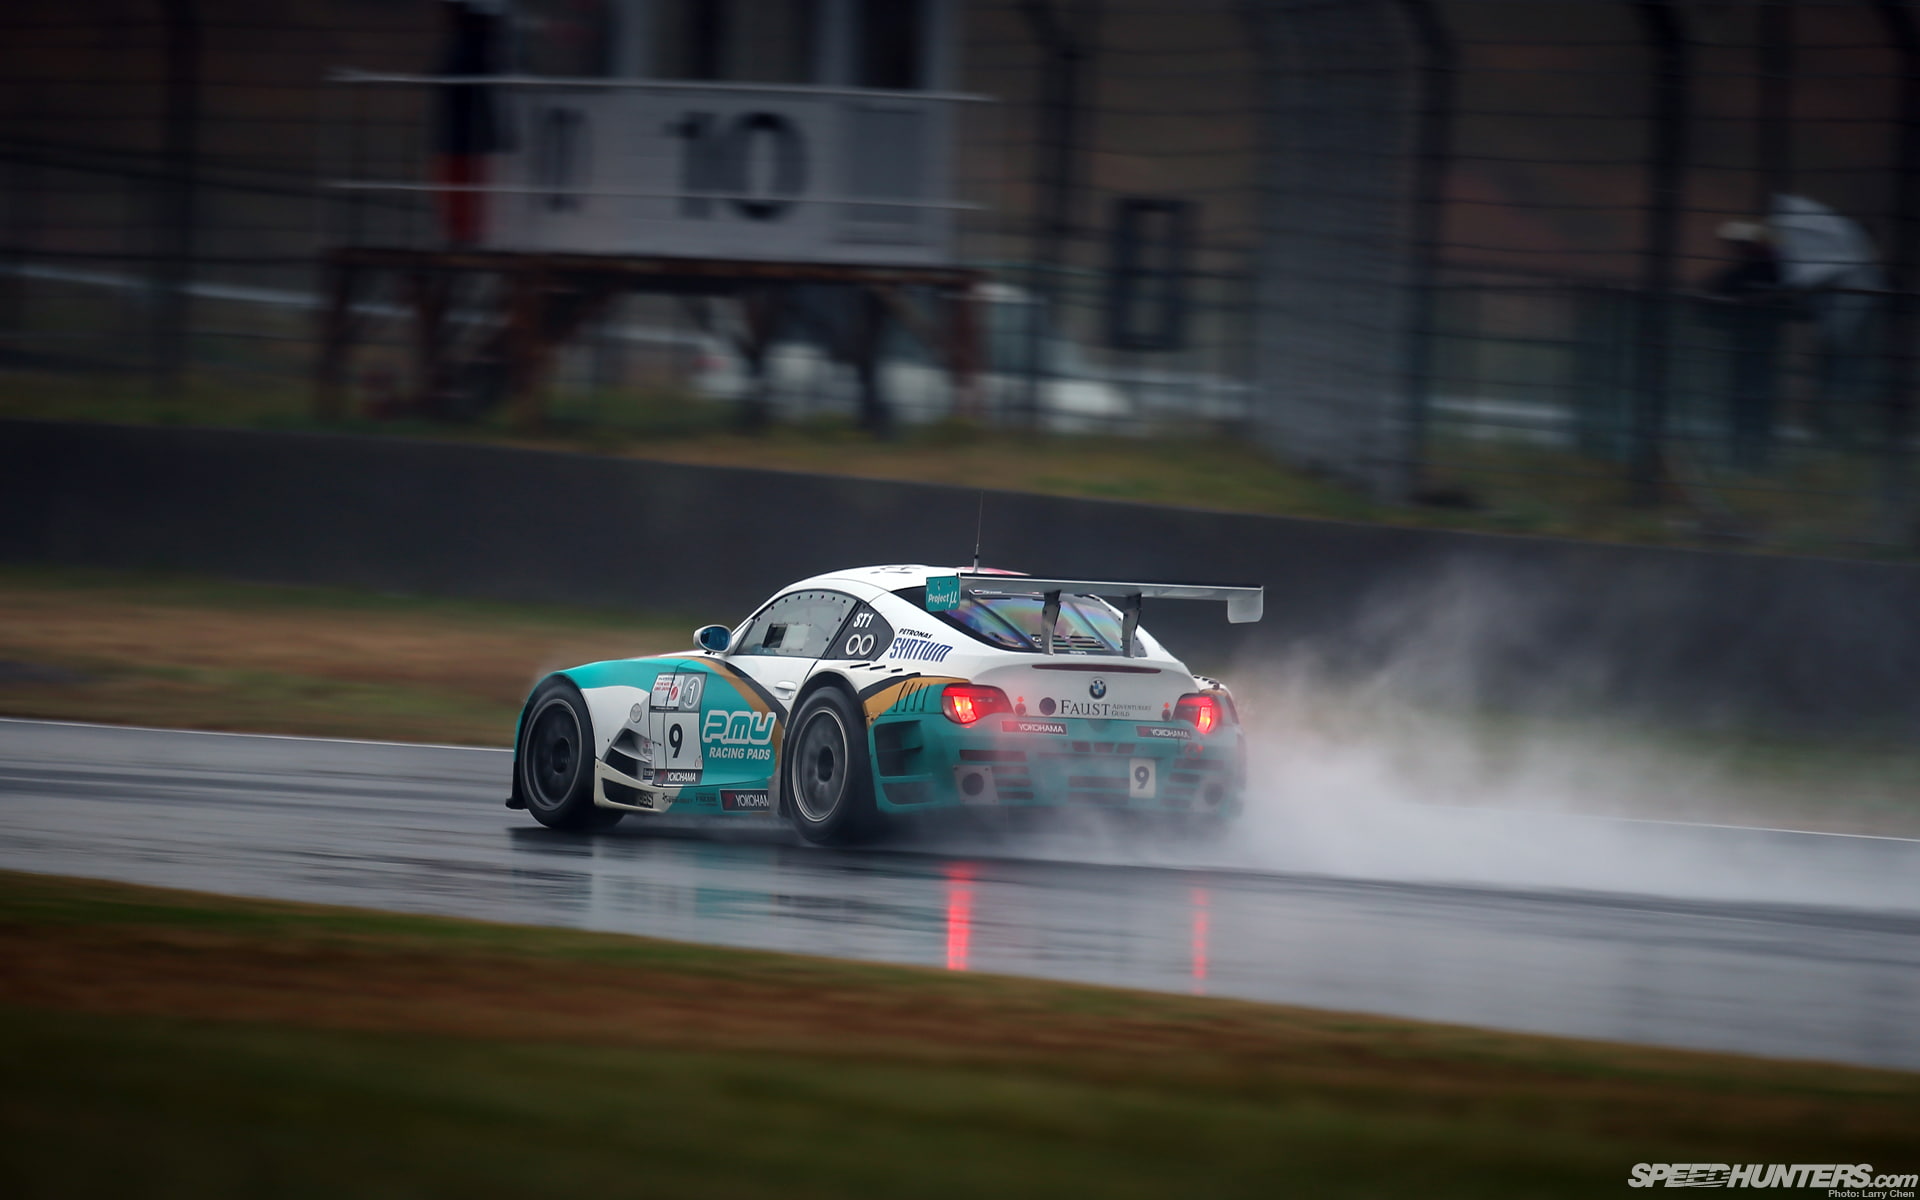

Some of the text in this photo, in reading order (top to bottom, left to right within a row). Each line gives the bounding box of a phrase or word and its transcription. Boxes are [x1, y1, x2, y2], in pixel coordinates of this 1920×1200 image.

[660, 109, 810, 222] 10
[928, 593, 949, 604] Project
[853, 613, 874, 628] ST1
[898, 628, 933, 639] PETRONAS
[889, 637, 953, 662] SYNTIUM
[1060, 699, 1110, 716] FAUST
[1018, 723, 1064, 733] YOKOHAMA
[1150, 728, 1190, 738] YOKOHAMA
[669, 723, 683, 758] 9
[709, 747, 771, 760] RACING PADS
[667, 771, 696, 782] YOKOHAMA
[1134, 766, 1150, 790] 9
